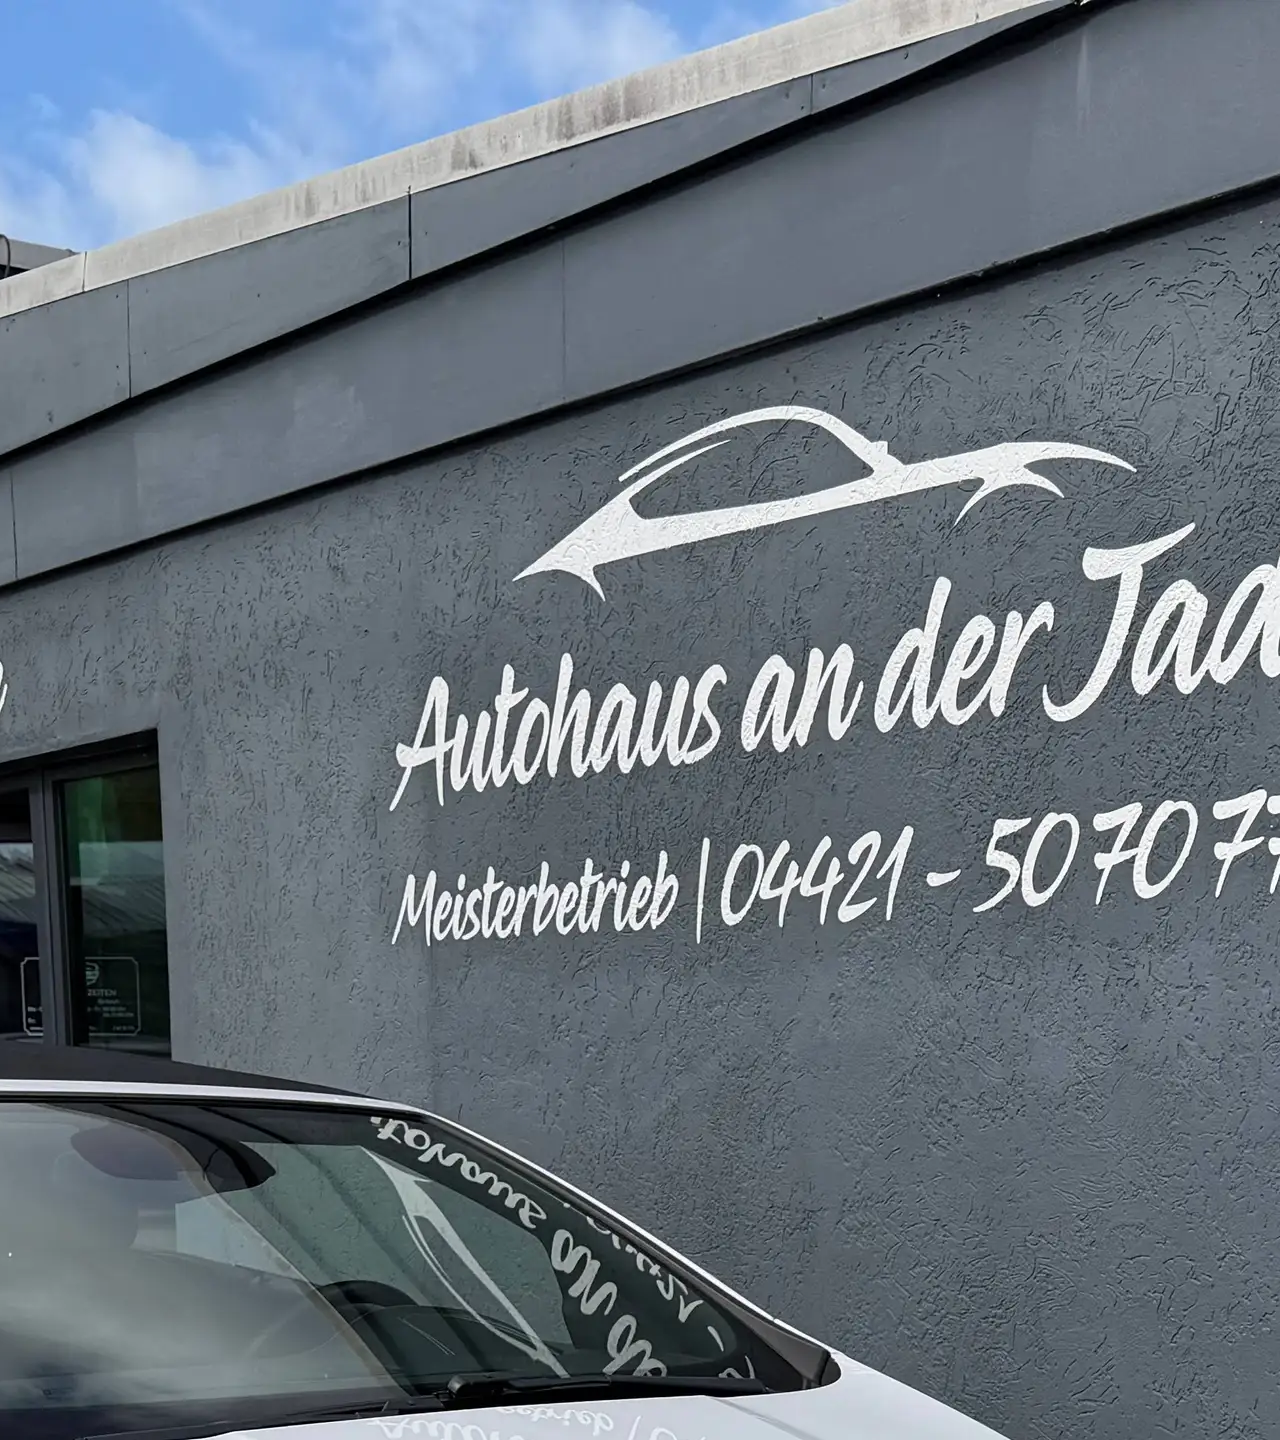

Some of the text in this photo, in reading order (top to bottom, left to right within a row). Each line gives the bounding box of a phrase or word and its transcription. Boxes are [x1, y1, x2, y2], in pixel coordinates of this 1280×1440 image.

[390, 653, 727, 812] Autohaus
[741, 643, 864, 753] an
[873, 576, 1055, 733] der
[391, 850, 678, 947] Meisterbetrieb
[720, 825, 914, 927] 04421
